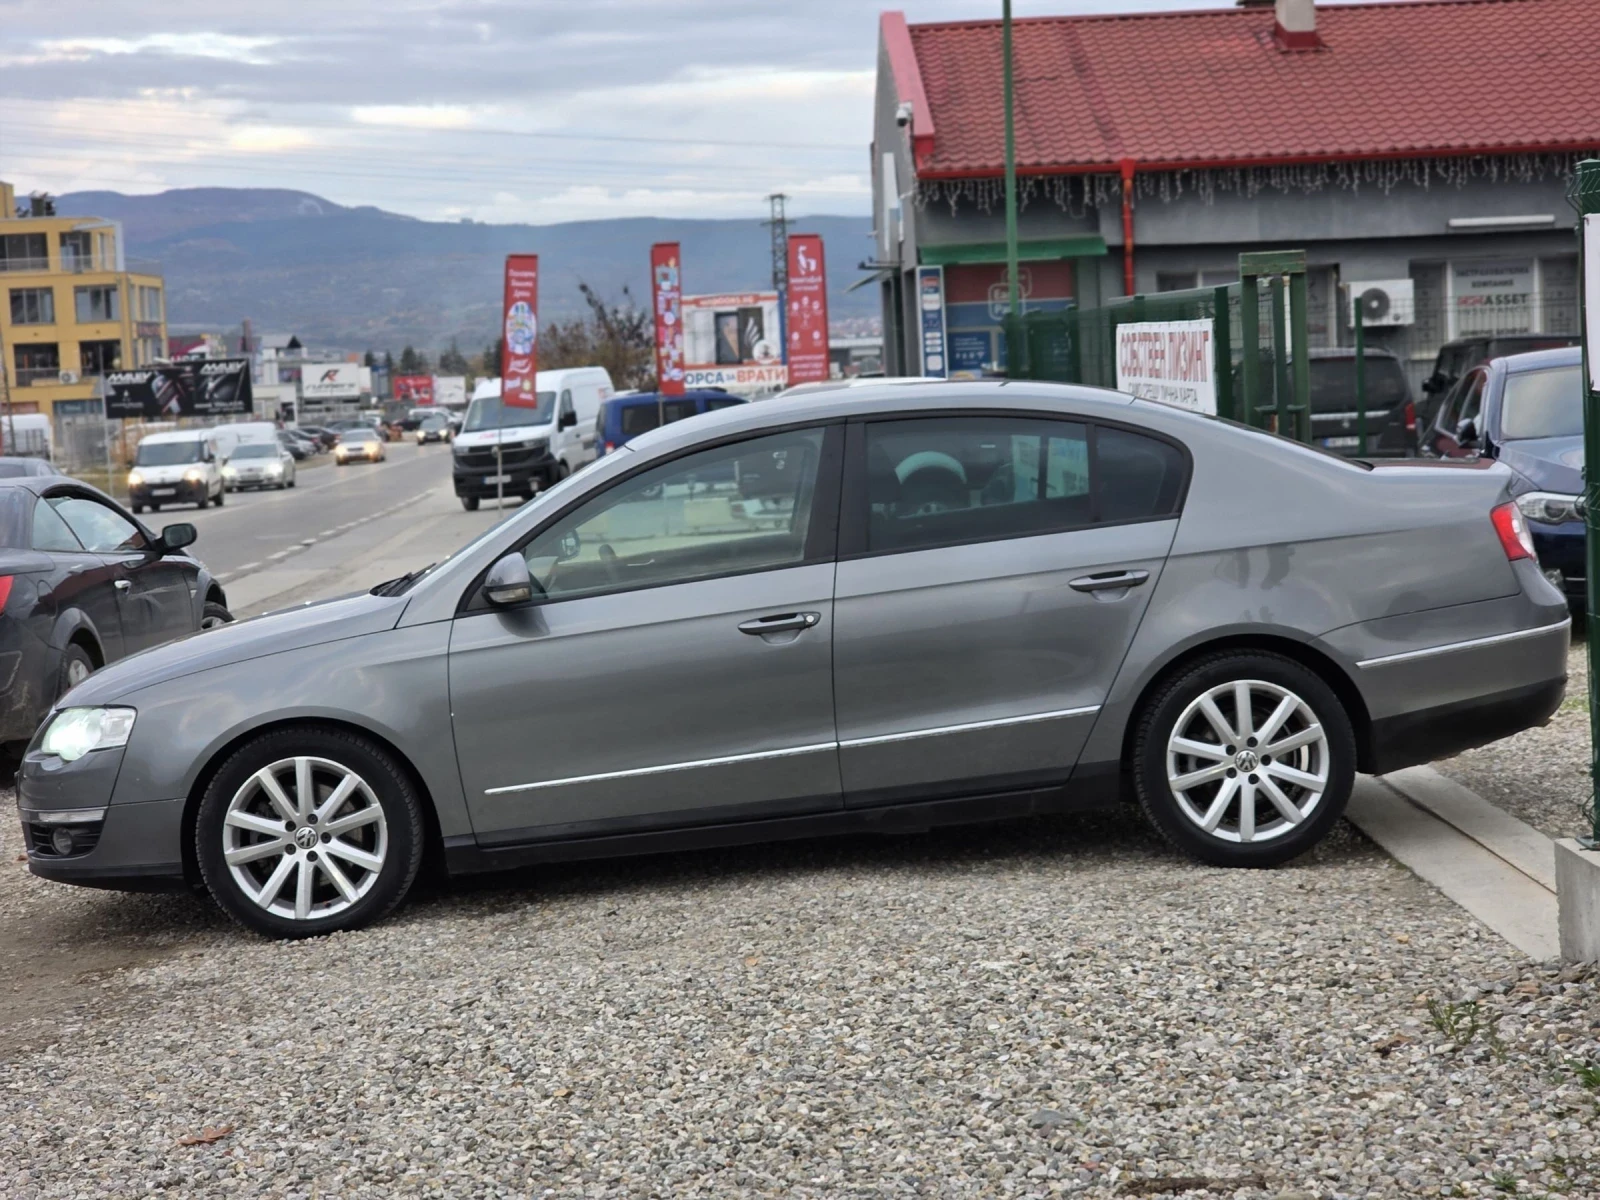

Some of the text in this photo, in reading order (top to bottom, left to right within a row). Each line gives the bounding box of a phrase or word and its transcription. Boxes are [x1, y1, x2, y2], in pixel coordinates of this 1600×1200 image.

[1484, 293, 1529, 305] ASSET
[1121, 330, 1209, 382] СОБСТВЕН ЛИЗИНГ
[684, 371, 725, 385] ОРСА
[736, 367, 786, 384] ВРАТИ
